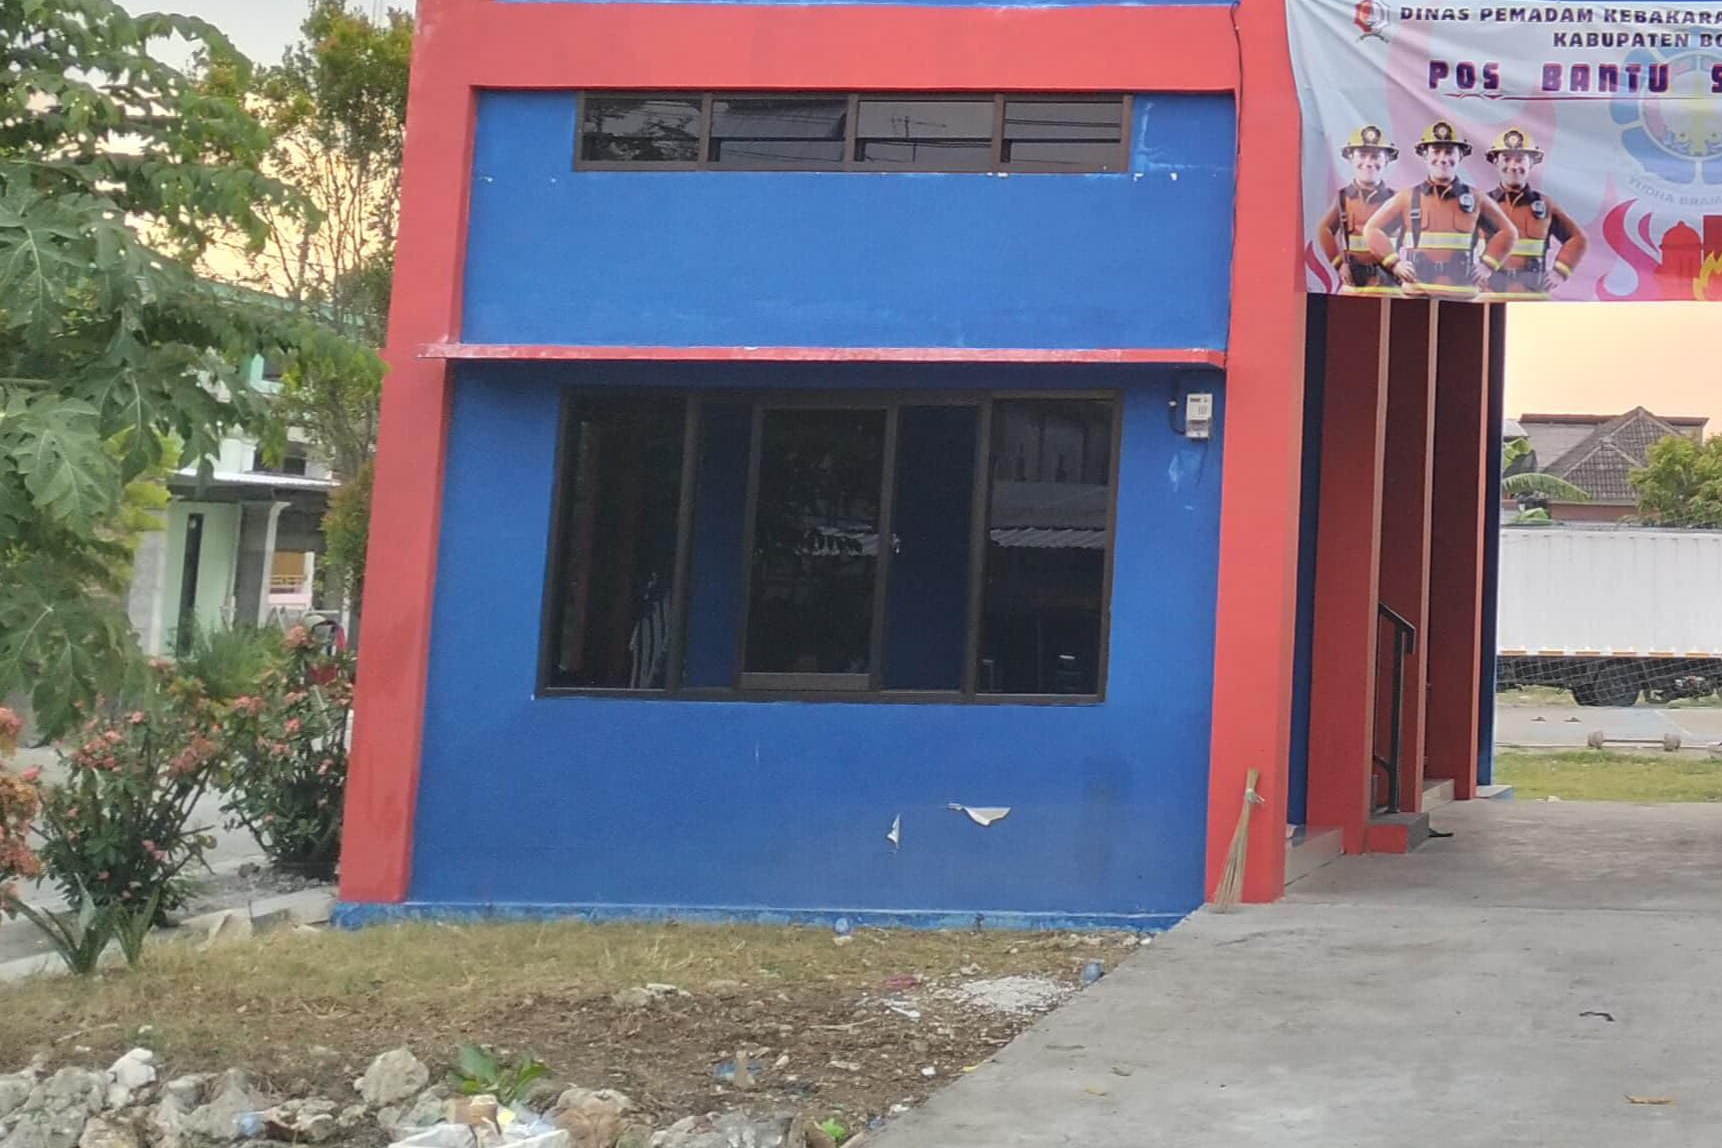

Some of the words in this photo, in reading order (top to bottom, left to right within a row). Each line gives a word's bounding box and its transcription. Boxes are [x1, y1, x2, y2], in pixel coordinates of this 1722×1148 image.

[1400, 7, 1470, 21] DINAS
[1480, 7, 1594, 24] PEMADAM
[1553, 32, 1689, 48] KABUPATEN
[1428, 60, 1500, 90] POS
[1542, 63, 1669, 92] BANTU
